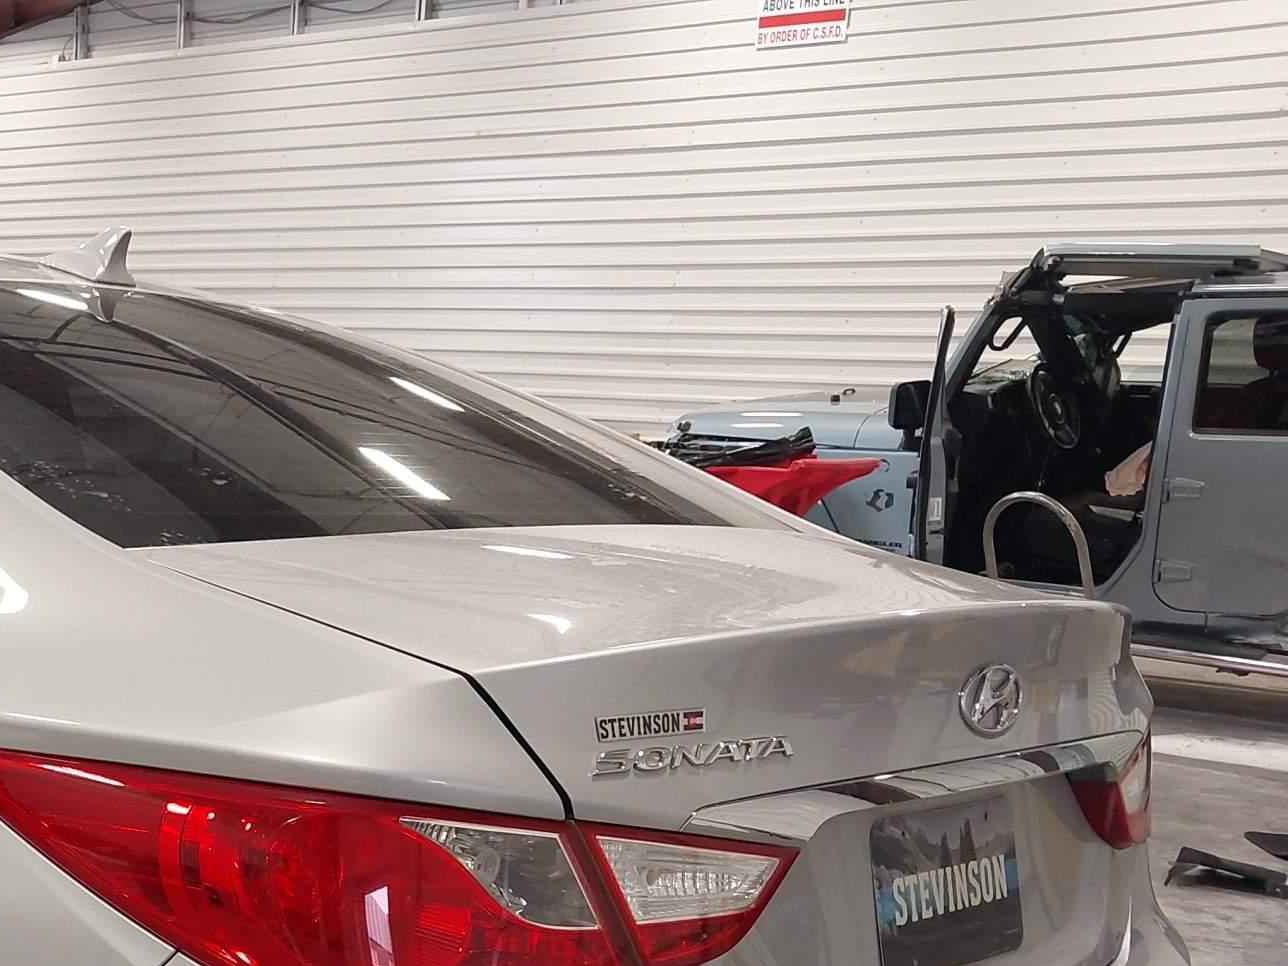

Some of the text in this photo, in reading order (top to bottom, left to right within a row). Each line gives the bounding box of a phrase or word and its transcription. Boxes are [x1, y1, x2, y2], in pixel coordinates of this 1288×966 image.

[762, 0, 795, 12] ABOVE
[757, 32, 770, 45] BY
[770, 29, 798, 43] ORDER
[799, 28, 811, 41] OF
[598, 711, 681, 740] STEVINSON
[591, 735, 795, 777] SONATA
[892, 854, 1009, 927] STEVINSON
